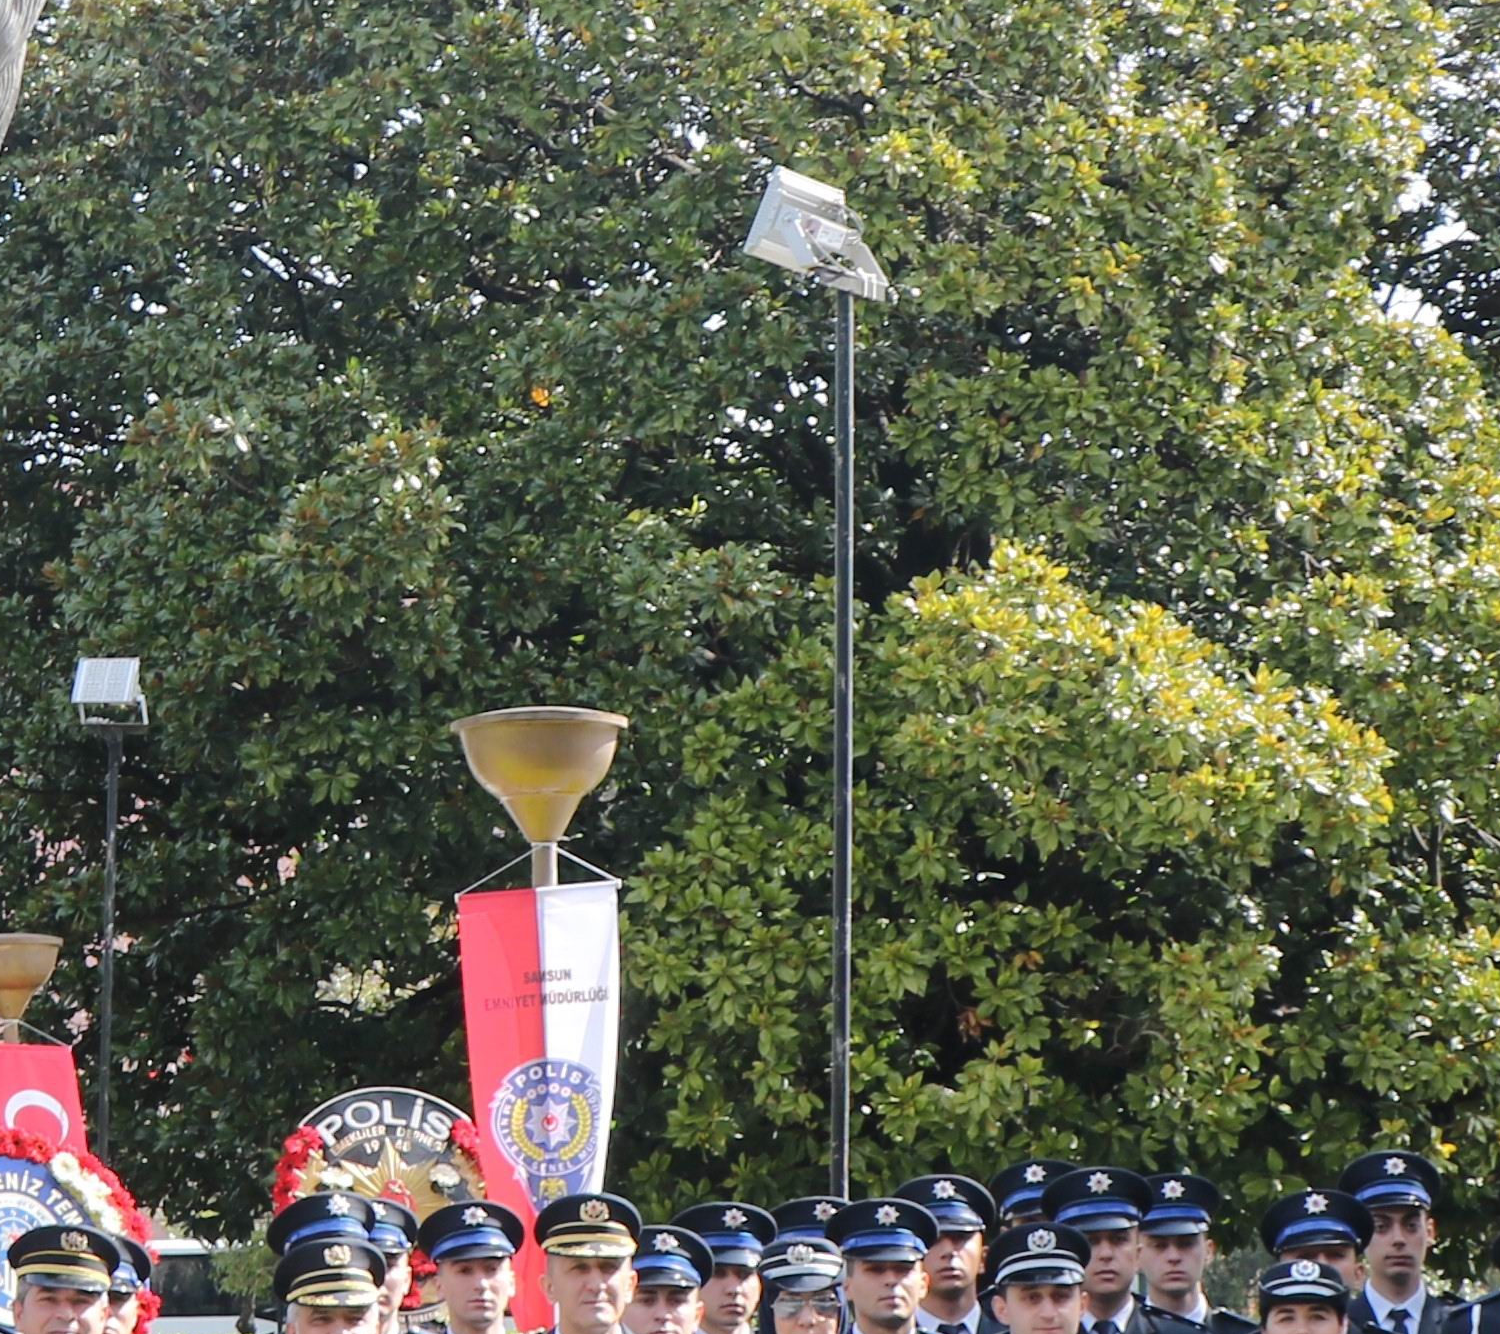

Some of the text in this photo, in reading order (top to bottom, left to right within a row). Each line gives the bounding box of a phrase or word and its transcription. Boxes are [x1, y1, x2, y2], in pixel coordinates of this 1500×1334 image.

[523, 969, 572, 984] SAMSUN
[315, 1097, 453, 1147] POLİS
[363, 1139, 381, 1155] 19
